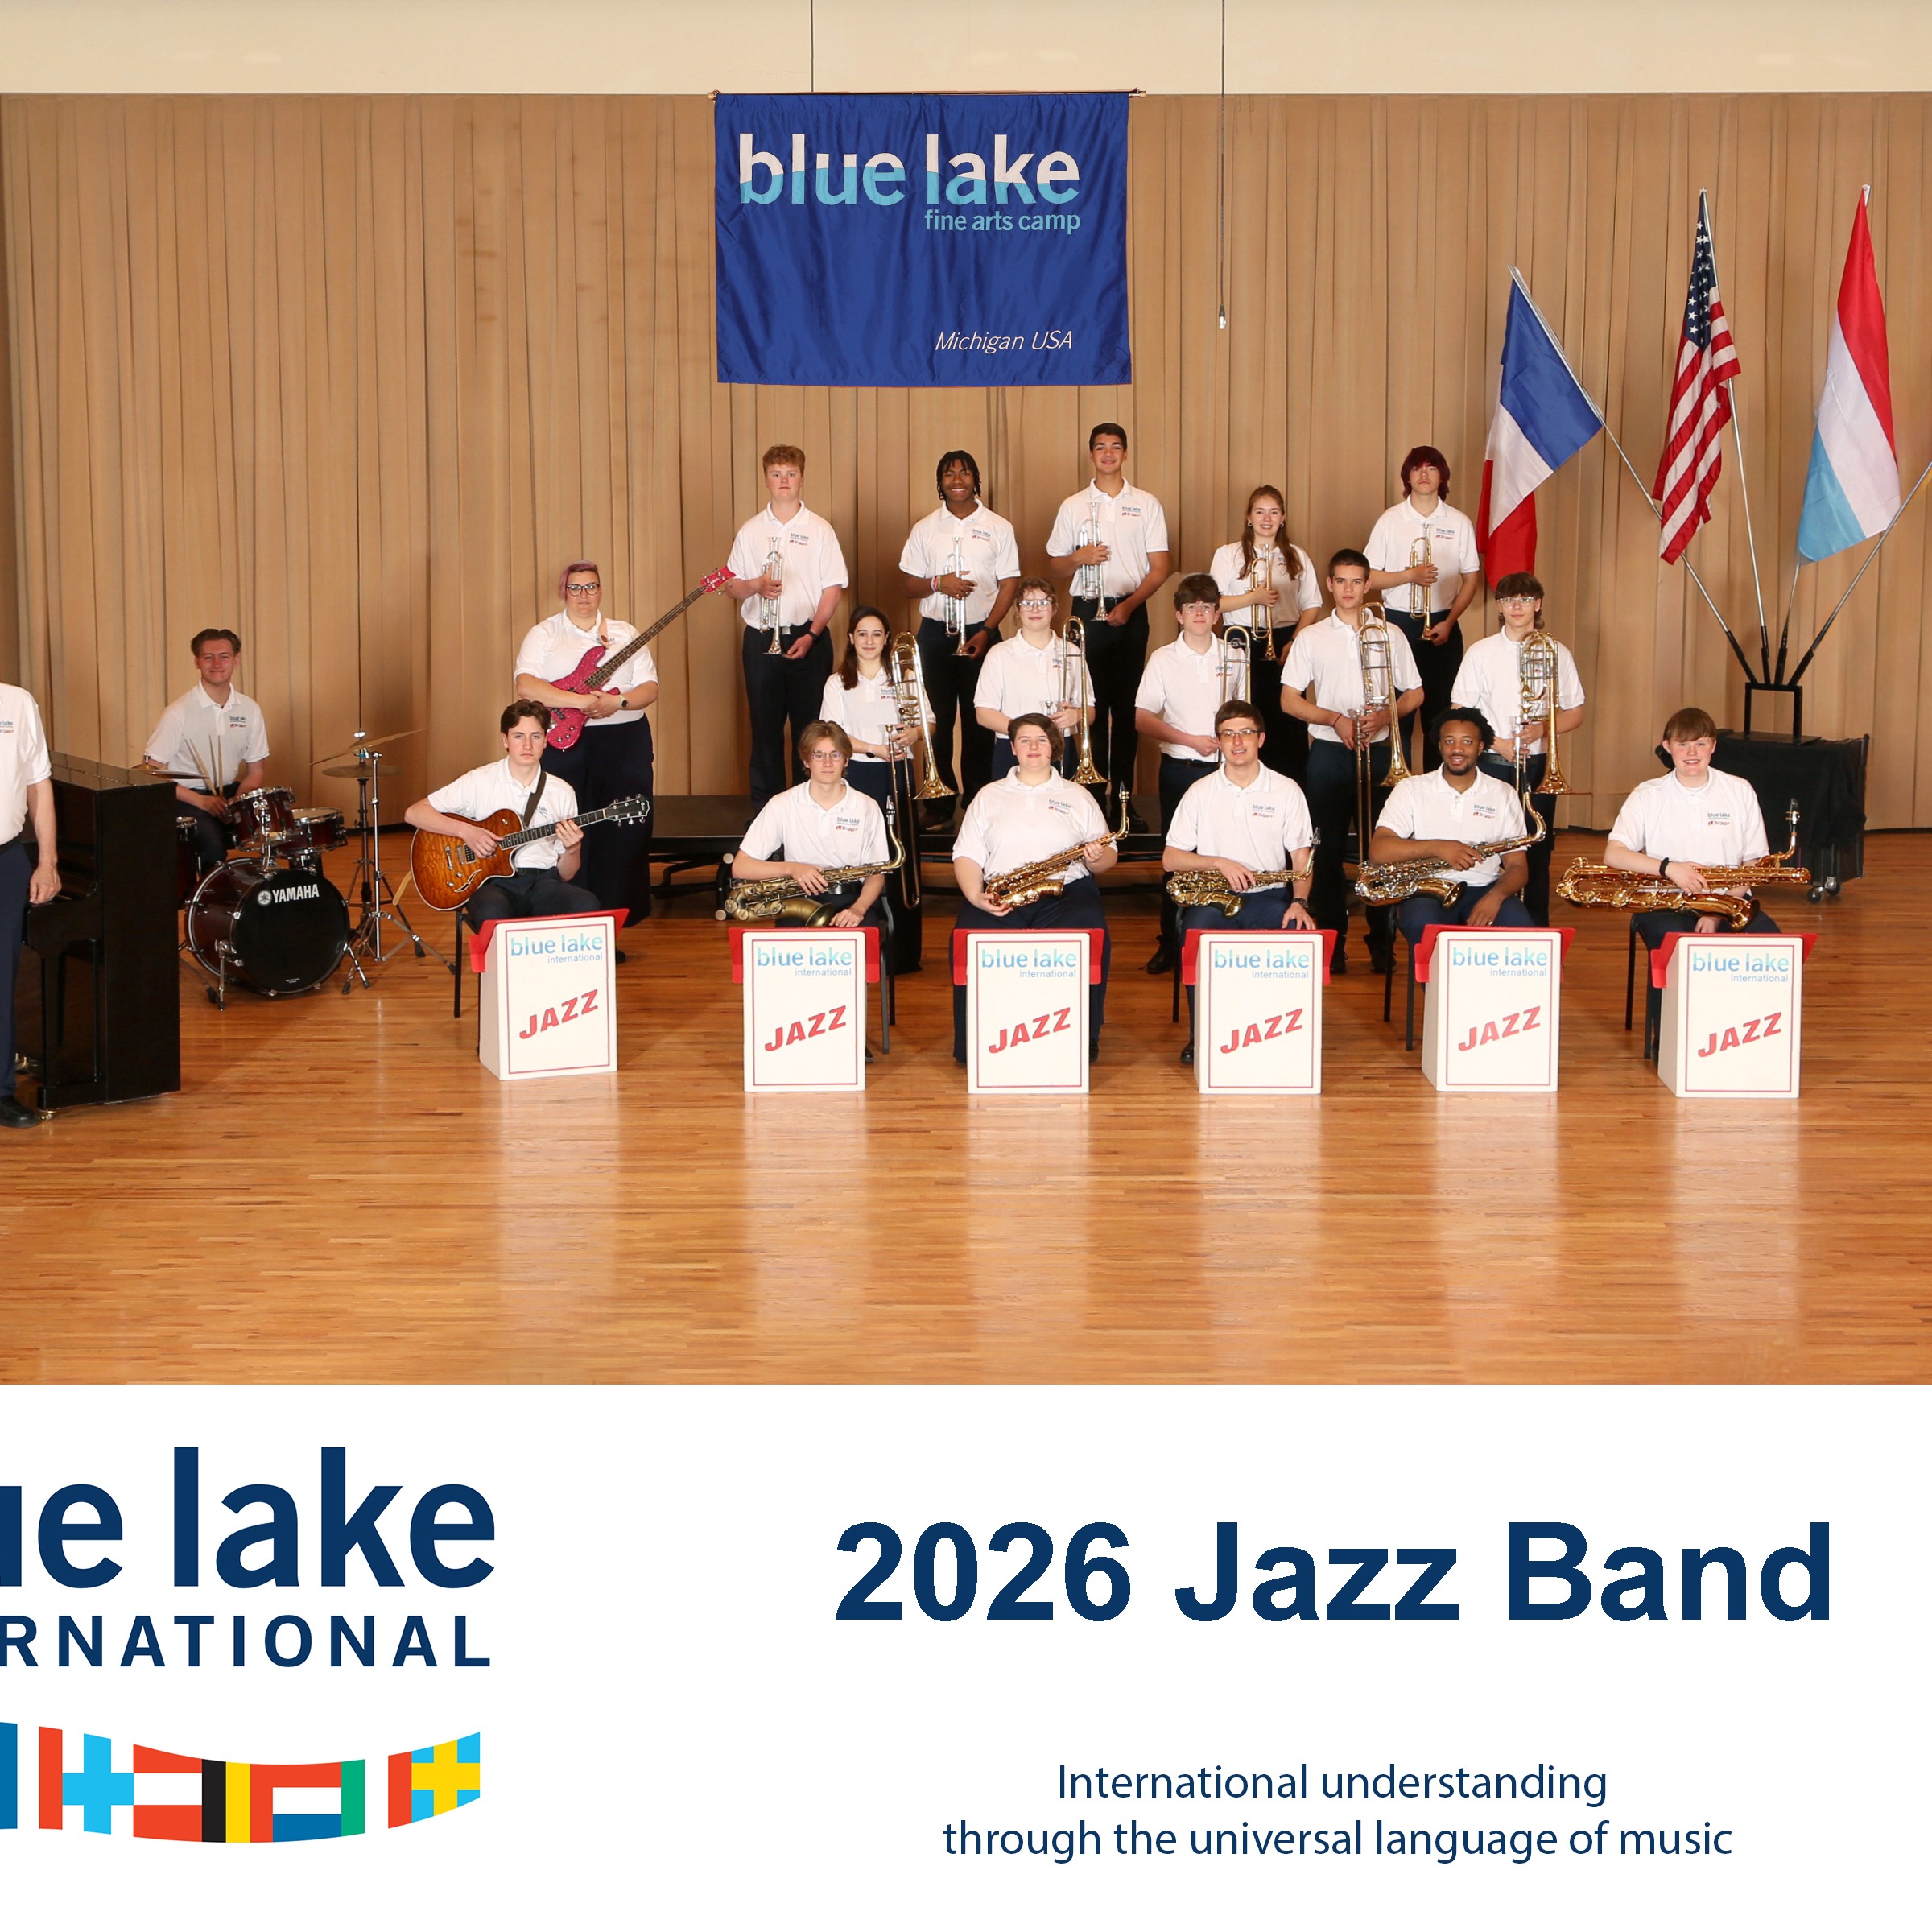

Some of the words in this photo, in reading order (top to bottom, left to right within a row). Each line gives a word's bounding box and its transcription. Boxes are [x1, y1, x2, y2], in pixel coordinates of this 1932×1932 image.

[739, 133, 906, 206] blue
[926, 134, 1080, 206] lake
[925, 208, 967, 231] fine
[972, 210, 1014, 231] arts
[1018, 214, 1081, 235] camp
[935, 331, 1025, 354] Michigan
[1031, 330, 1073, 350] USA
[272, 884, 320, 903] YAMAHA
[510, 938, 555, 956] blue
[561, 933, 603, 952] lake
[547, 952, 602, 964] international
[757, 947, 803, 966] blue
[809, 947, 852, 966] lake
[981, 949, 1028, 968] blue
[1034, 948, 1076, 968] lake
[1214, 949, 1261, 968] blue
[1266, 949, 1309, 968] lake
[1452, 947, 1499, 966] blue
[1505, 947, 1547, 966] lake
[1693, 952, 1740, 972] blue
[1745, 952, 1789, 972] lake
[795, 968, 852, 976] international
[1019, 969, 1076, 978] international
[1252, 970, 1309, 979] international
[1490, 968, 1547, 976] international
[1731, 974, 1789, 982] international
[519, 989, 598, 1039] JAZZ
[764, 1005, 846, 1051] JAZZ
[988, 1007, 1071, 1054] JAZZ
[1220, 1008, 1302, 1054] JAZZ
[1458, 1005, 1541, 1051] JAZZ
[1698, 1012, 1781, 1057] JAZZ
